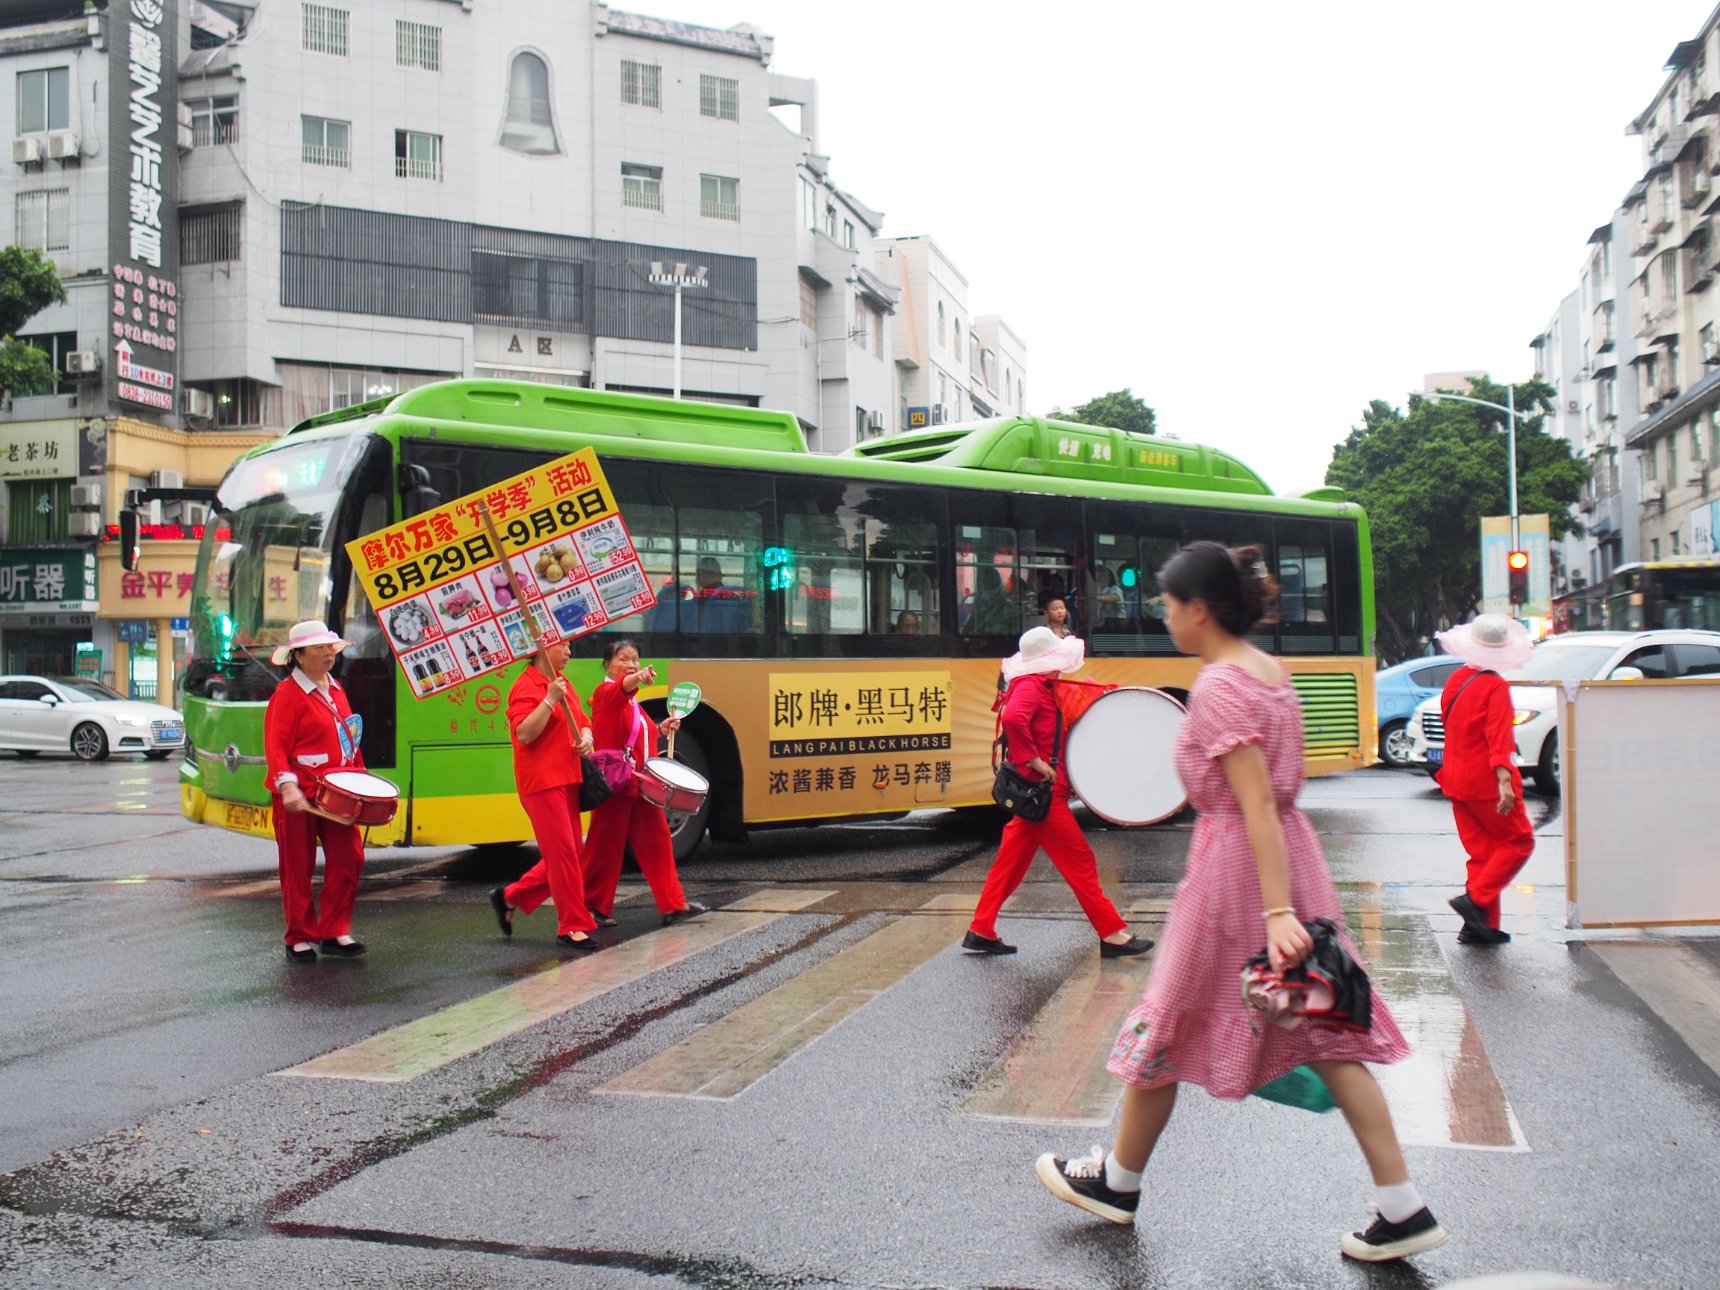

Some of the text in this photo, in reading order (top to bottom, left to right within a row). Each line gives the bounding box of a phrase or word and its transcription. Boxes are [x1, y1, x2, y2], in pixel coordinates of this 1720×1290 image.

[507, 334, 553, 355] A 区
[911, 413, 925, 426] 四
[546, 458, 592, 496] 活动
[567, 565, 585, 580] 0.98
[0, 564, 65, 600] 听器
[466, 604, 489, 621] 11.90
[582, 610, 604, 627] 12.90
[489, 648, 509, 664] 3.90
[442, 668, 461, 684] 8.50
[774, 686, 948, 729] 郎牌·黑马特
[773, 736, 949, 756] LANG PAI BLACK HORSE
[768, 760, 952, 796] 浓酱兼香 龙马奔腾
